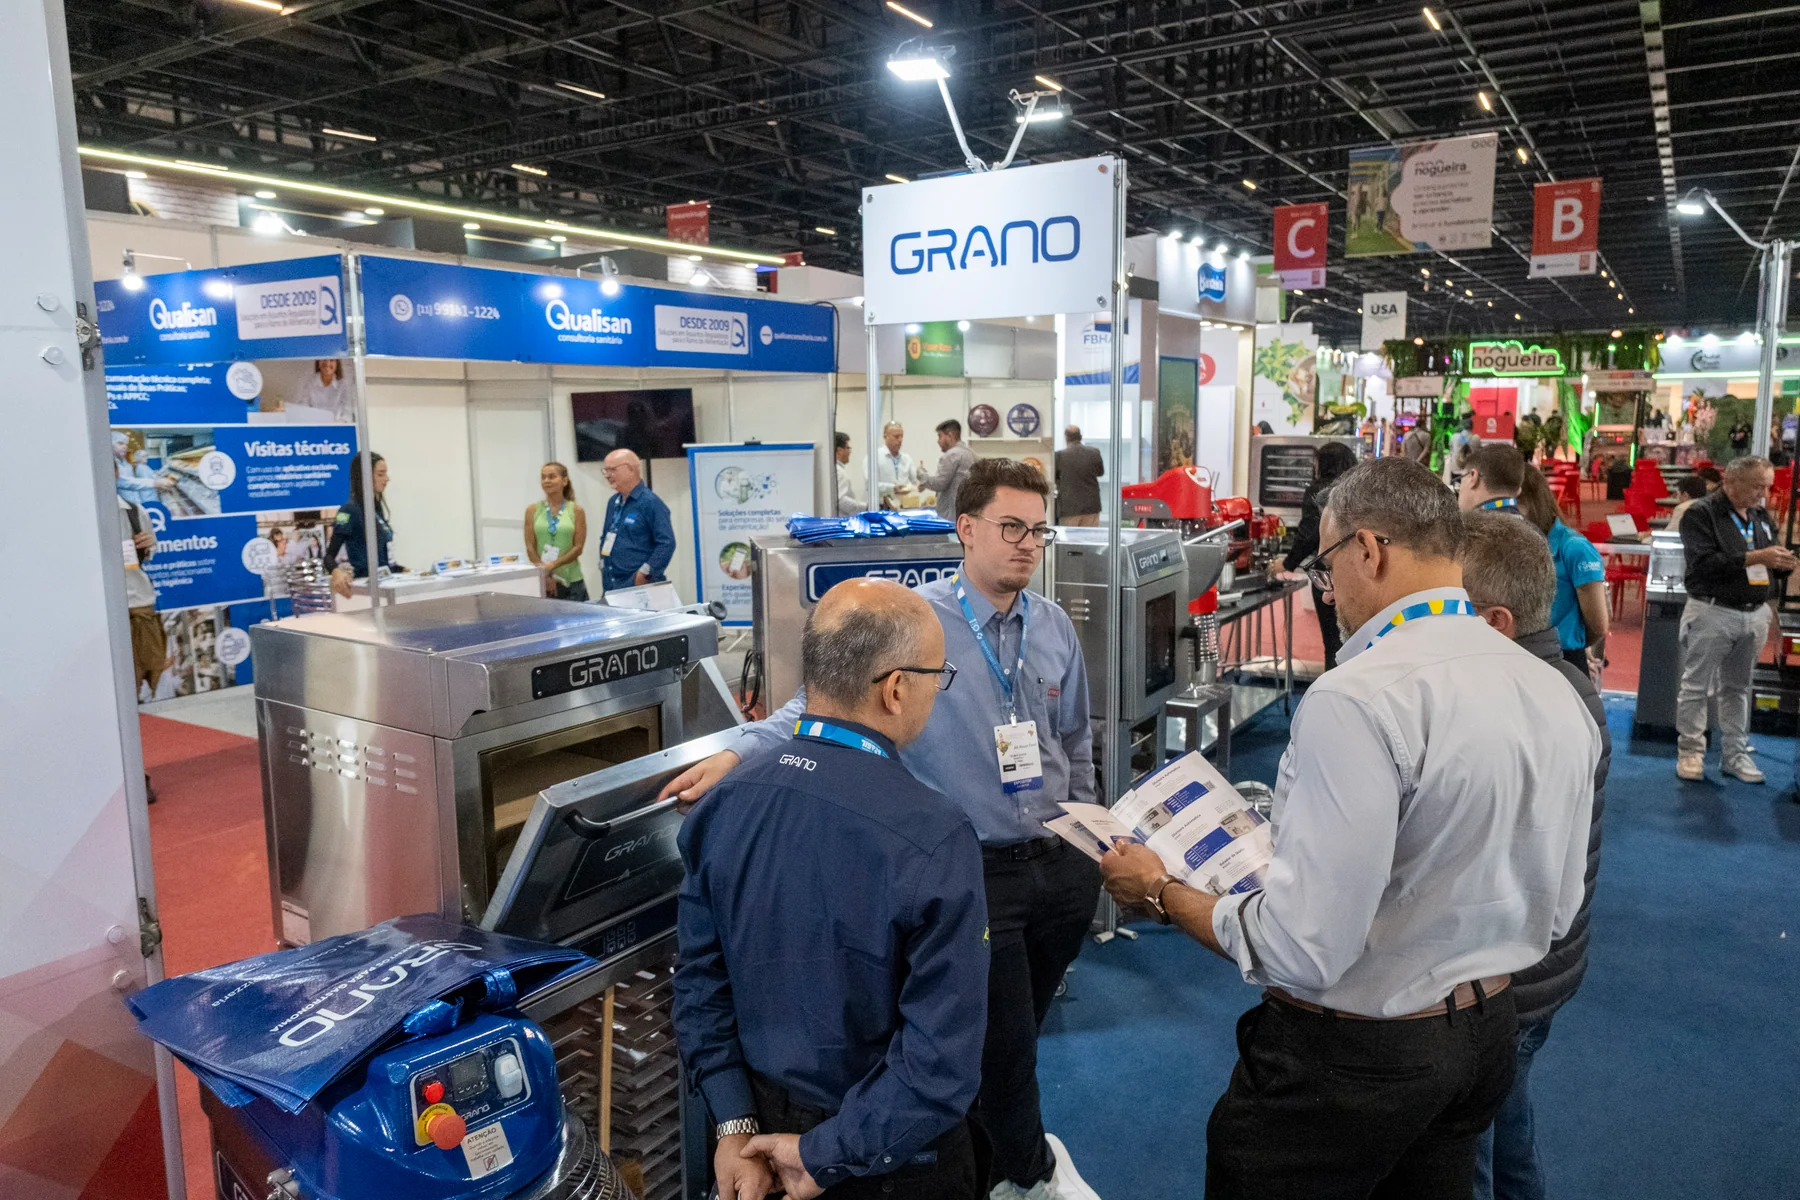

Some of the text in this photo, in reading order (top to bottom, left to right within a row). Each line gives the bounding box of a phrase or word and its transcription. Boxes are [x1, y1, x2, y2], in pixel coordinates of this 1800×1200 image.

[1415, 161, 1467, 177] nogueira
[1552, 197, 1584, 242] B
[890, 215, 1081, 276] GRANO
[1287, 218, 1316, 259] C
[261, 293, 291, 309] DESDE
[292, 290, 317, 307] 2009
[1370, 303, 1398, 315] USA
[149, 298, 217, 331] Qualisan
[545, 299, 632, 335] Qualisan
[680, 316, 708, 330] DESDE
[709, 319, 730, 332] 2009
[1474, 350, 1556, 371] nogueira
[105, 374, 151, 384] cumentação
[244, 439, 350, 457] Visitas técnicas
[718, 509, 781, 518] Soluções completas
[157, 534, 218, 553] mentos
[569, 645, 659, 687] GRANO
[779, 754, 817, 772] GRANO
[604, 823, 677, 862] GRANO
[348, 963, 382, 984] PARA
[212, 980, 256, 1007] izzaria
[279, 942, 482, 1048] GRANO
[271, 983, 348, 1033] GASTRONOMIA
[467, 1127, 497, 1144] ATENÇÃO
